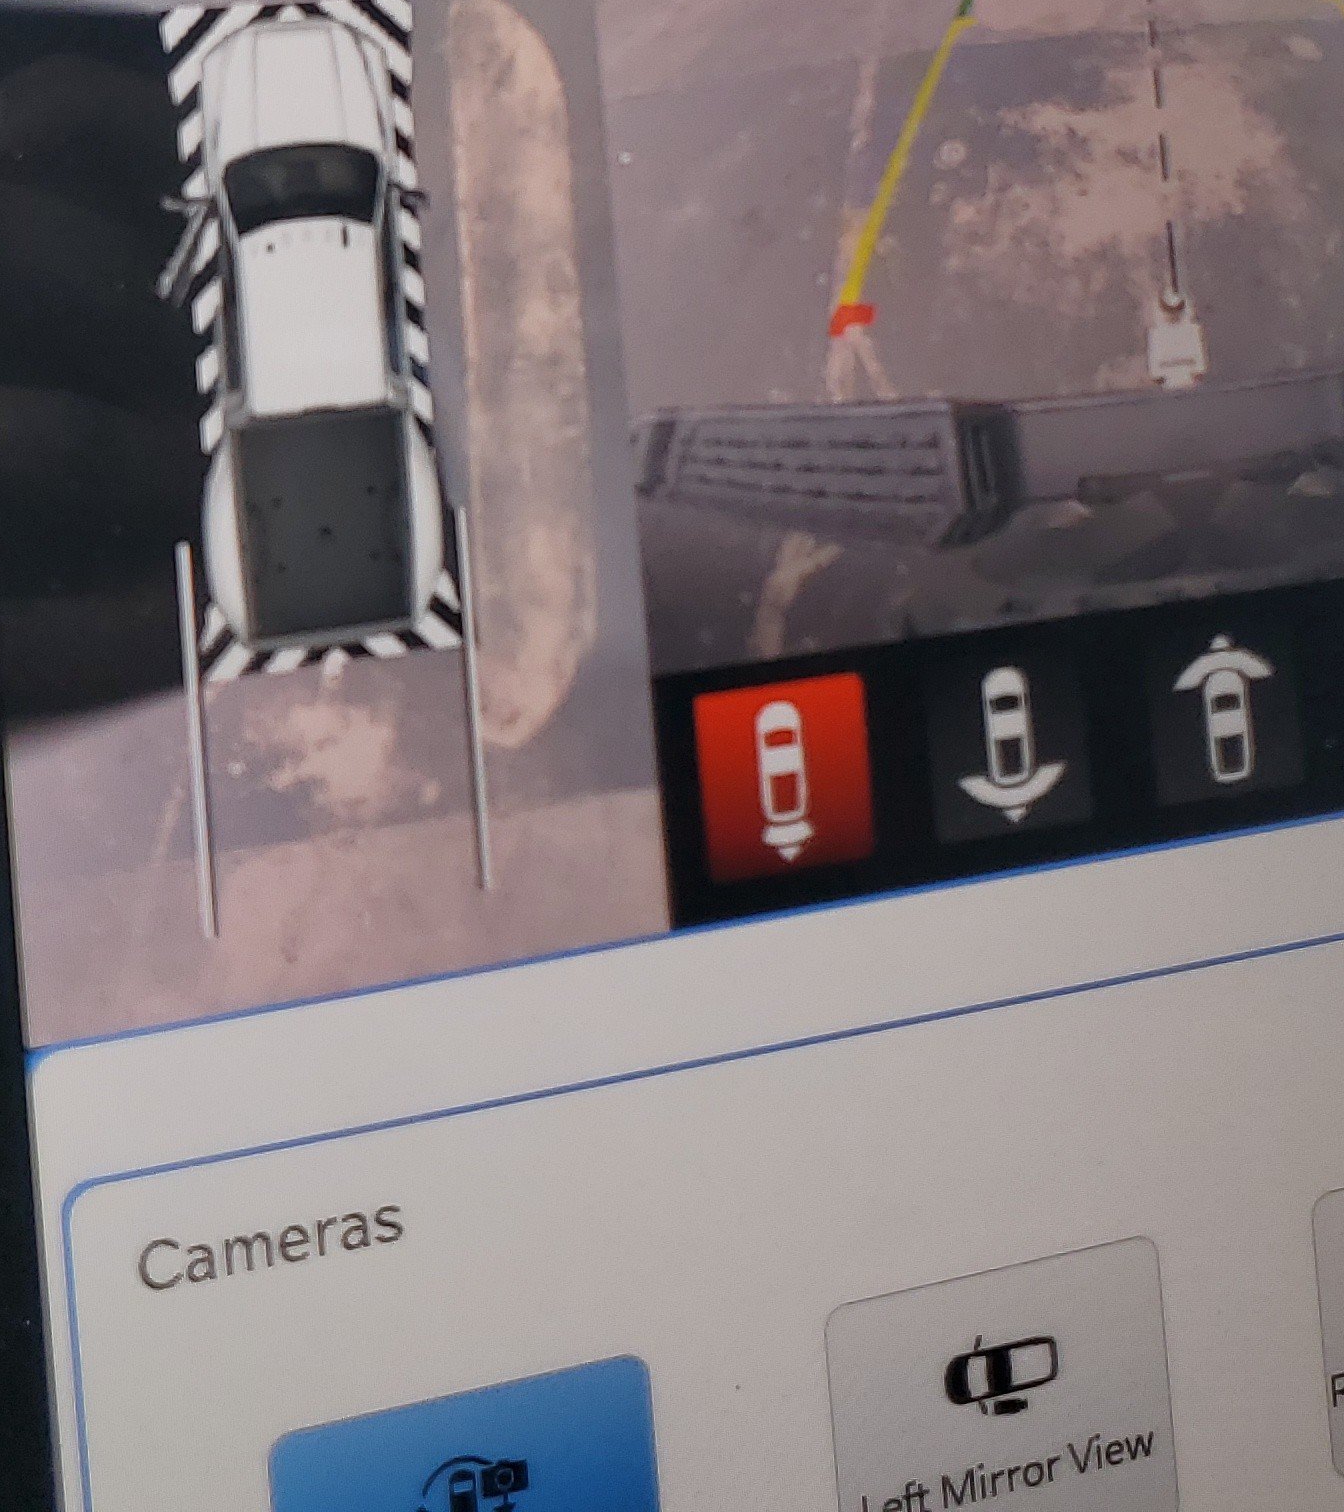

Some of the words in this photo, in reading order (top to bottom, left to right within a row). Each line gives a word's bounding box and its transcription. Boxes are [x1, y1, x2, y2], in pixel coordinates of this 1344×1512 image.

[137, 1203, 405, 1291] Cameras
[941, 1461, 1062, 1509] Mirror
[1067, 1432, 1155, 1474] View
